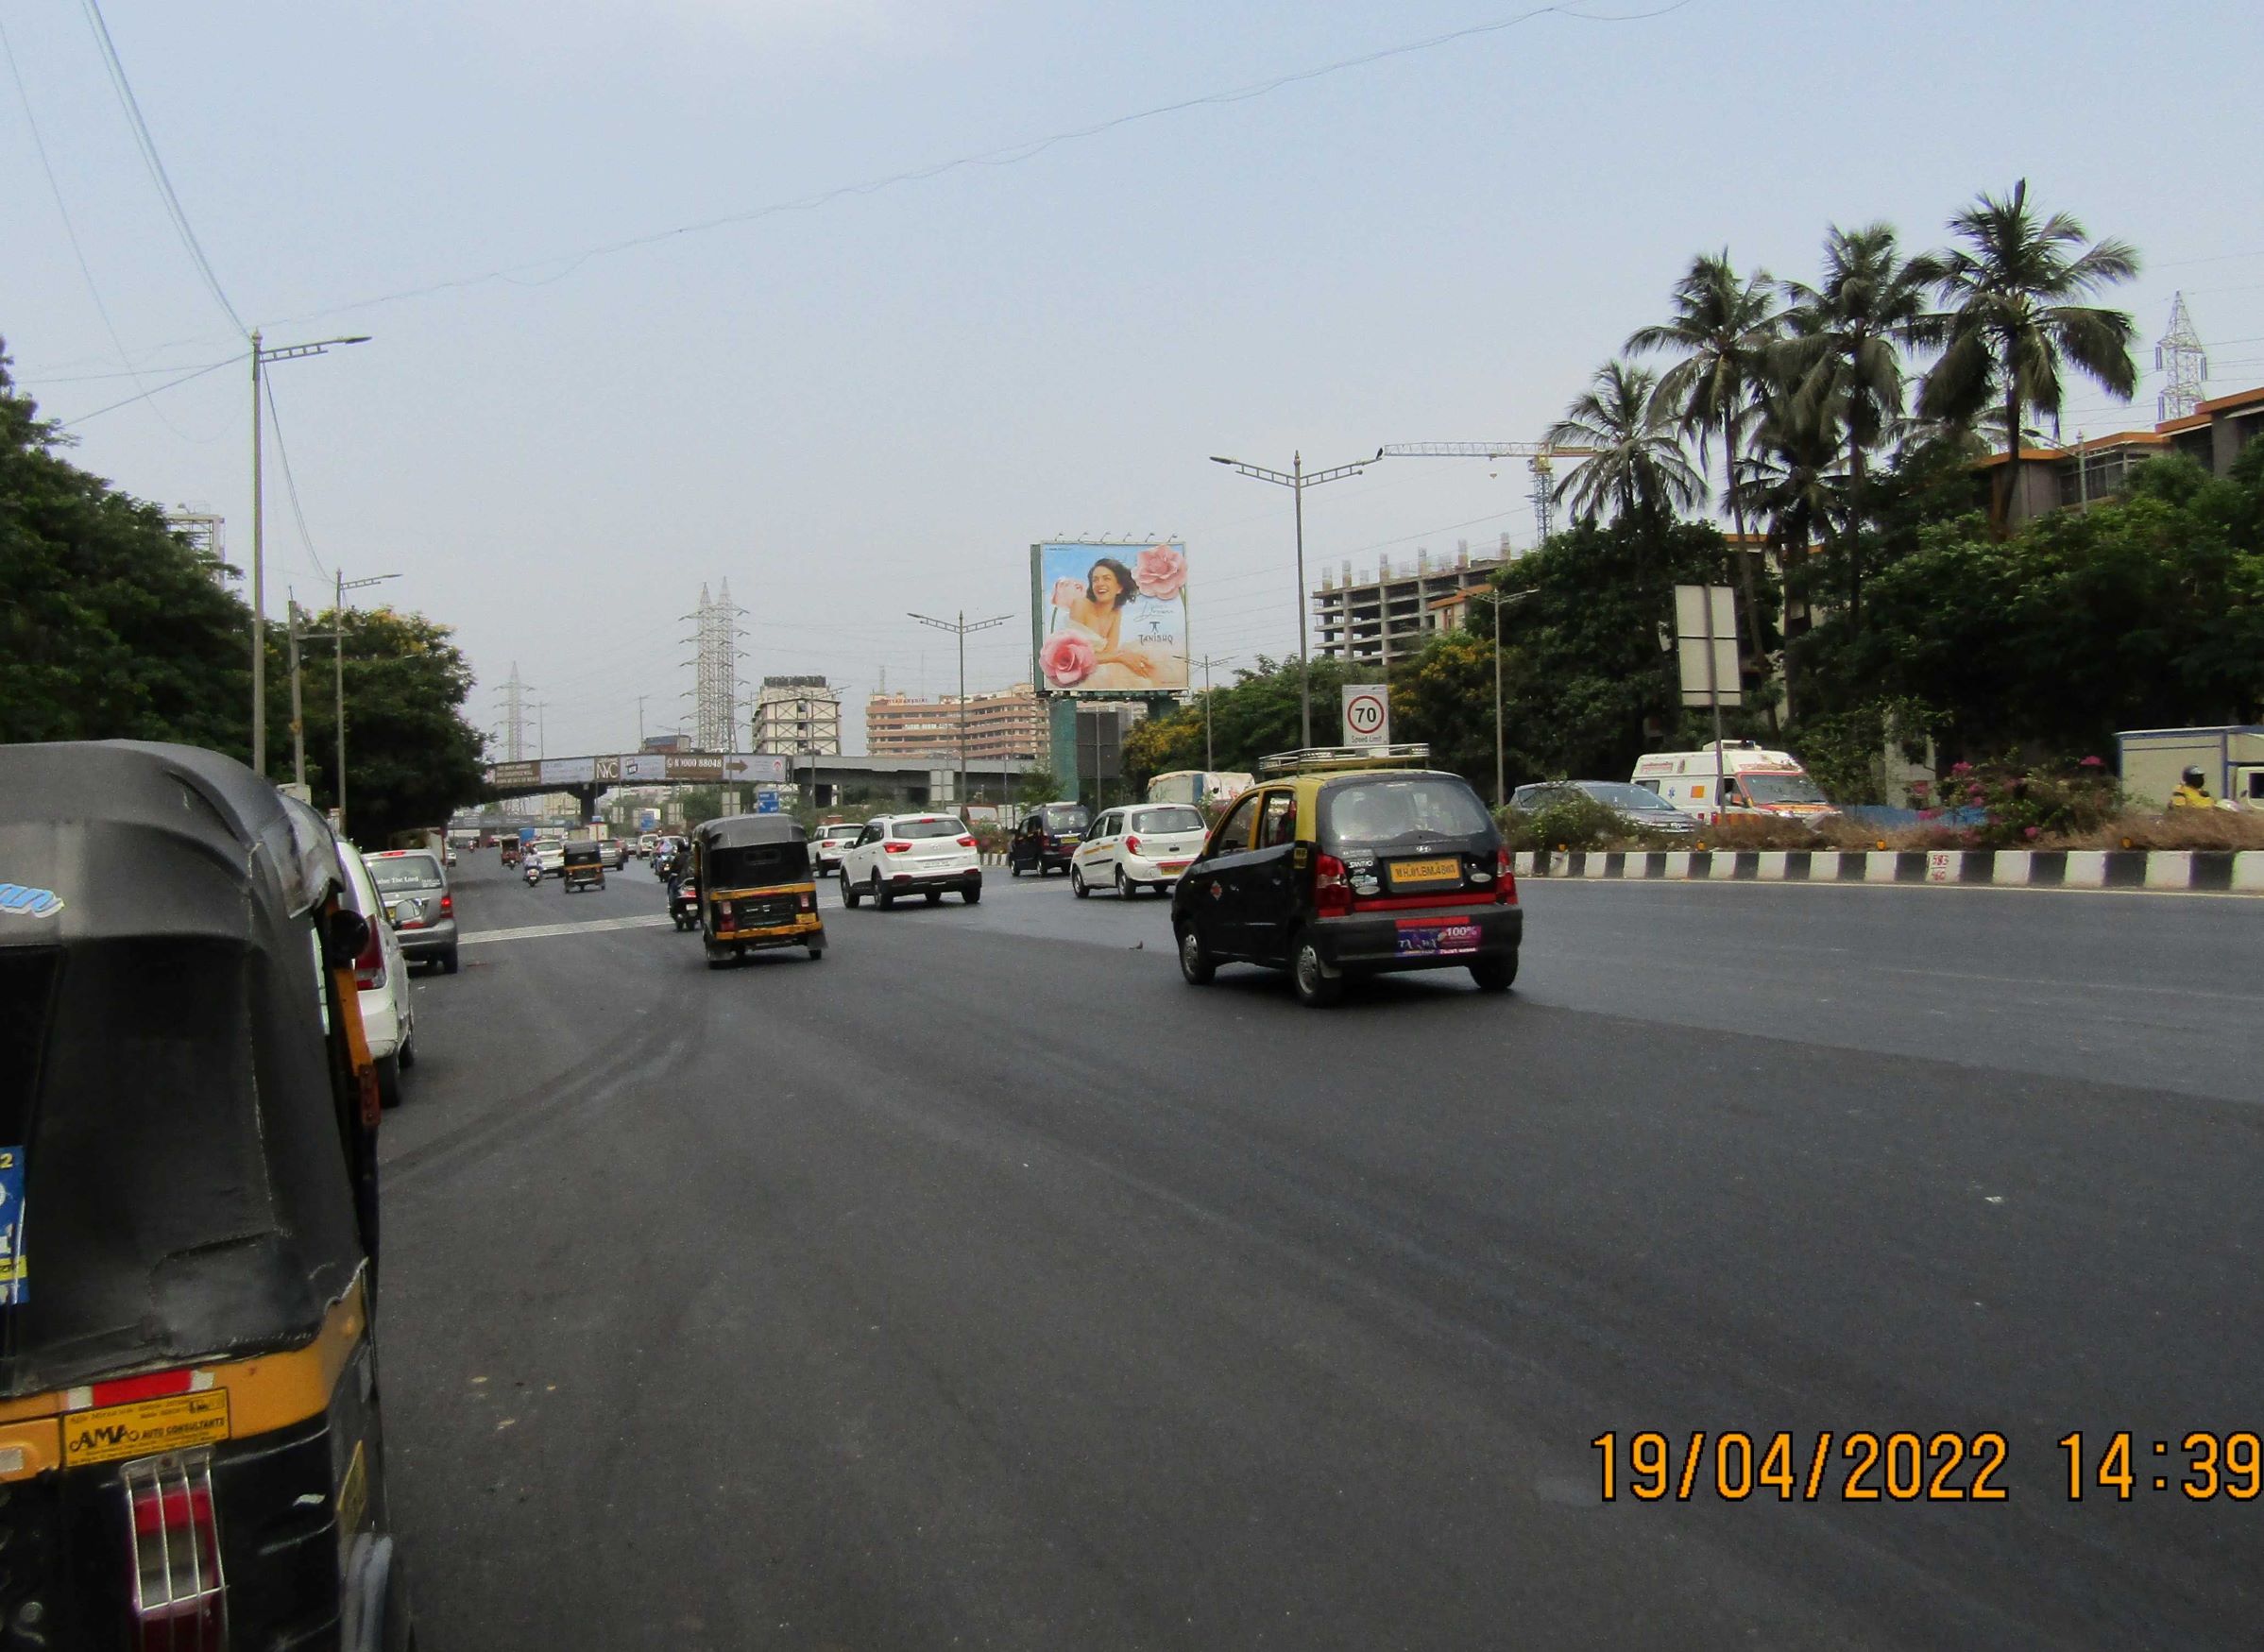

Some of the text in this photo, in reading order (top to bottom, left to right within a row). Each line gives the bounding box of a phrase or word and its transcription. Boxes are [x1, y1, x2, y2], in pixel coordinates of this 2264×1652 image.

[1138, 633, 1173, 646] TANISHQ
[1354, 707, 1377, 724] 70
[1352, 735, 1368, 744] Speed
[596, 762, 620, 779] NYC
[1445, 927, 1478, 937] 100%
[143, 1426, 164, 1439] AUTO
